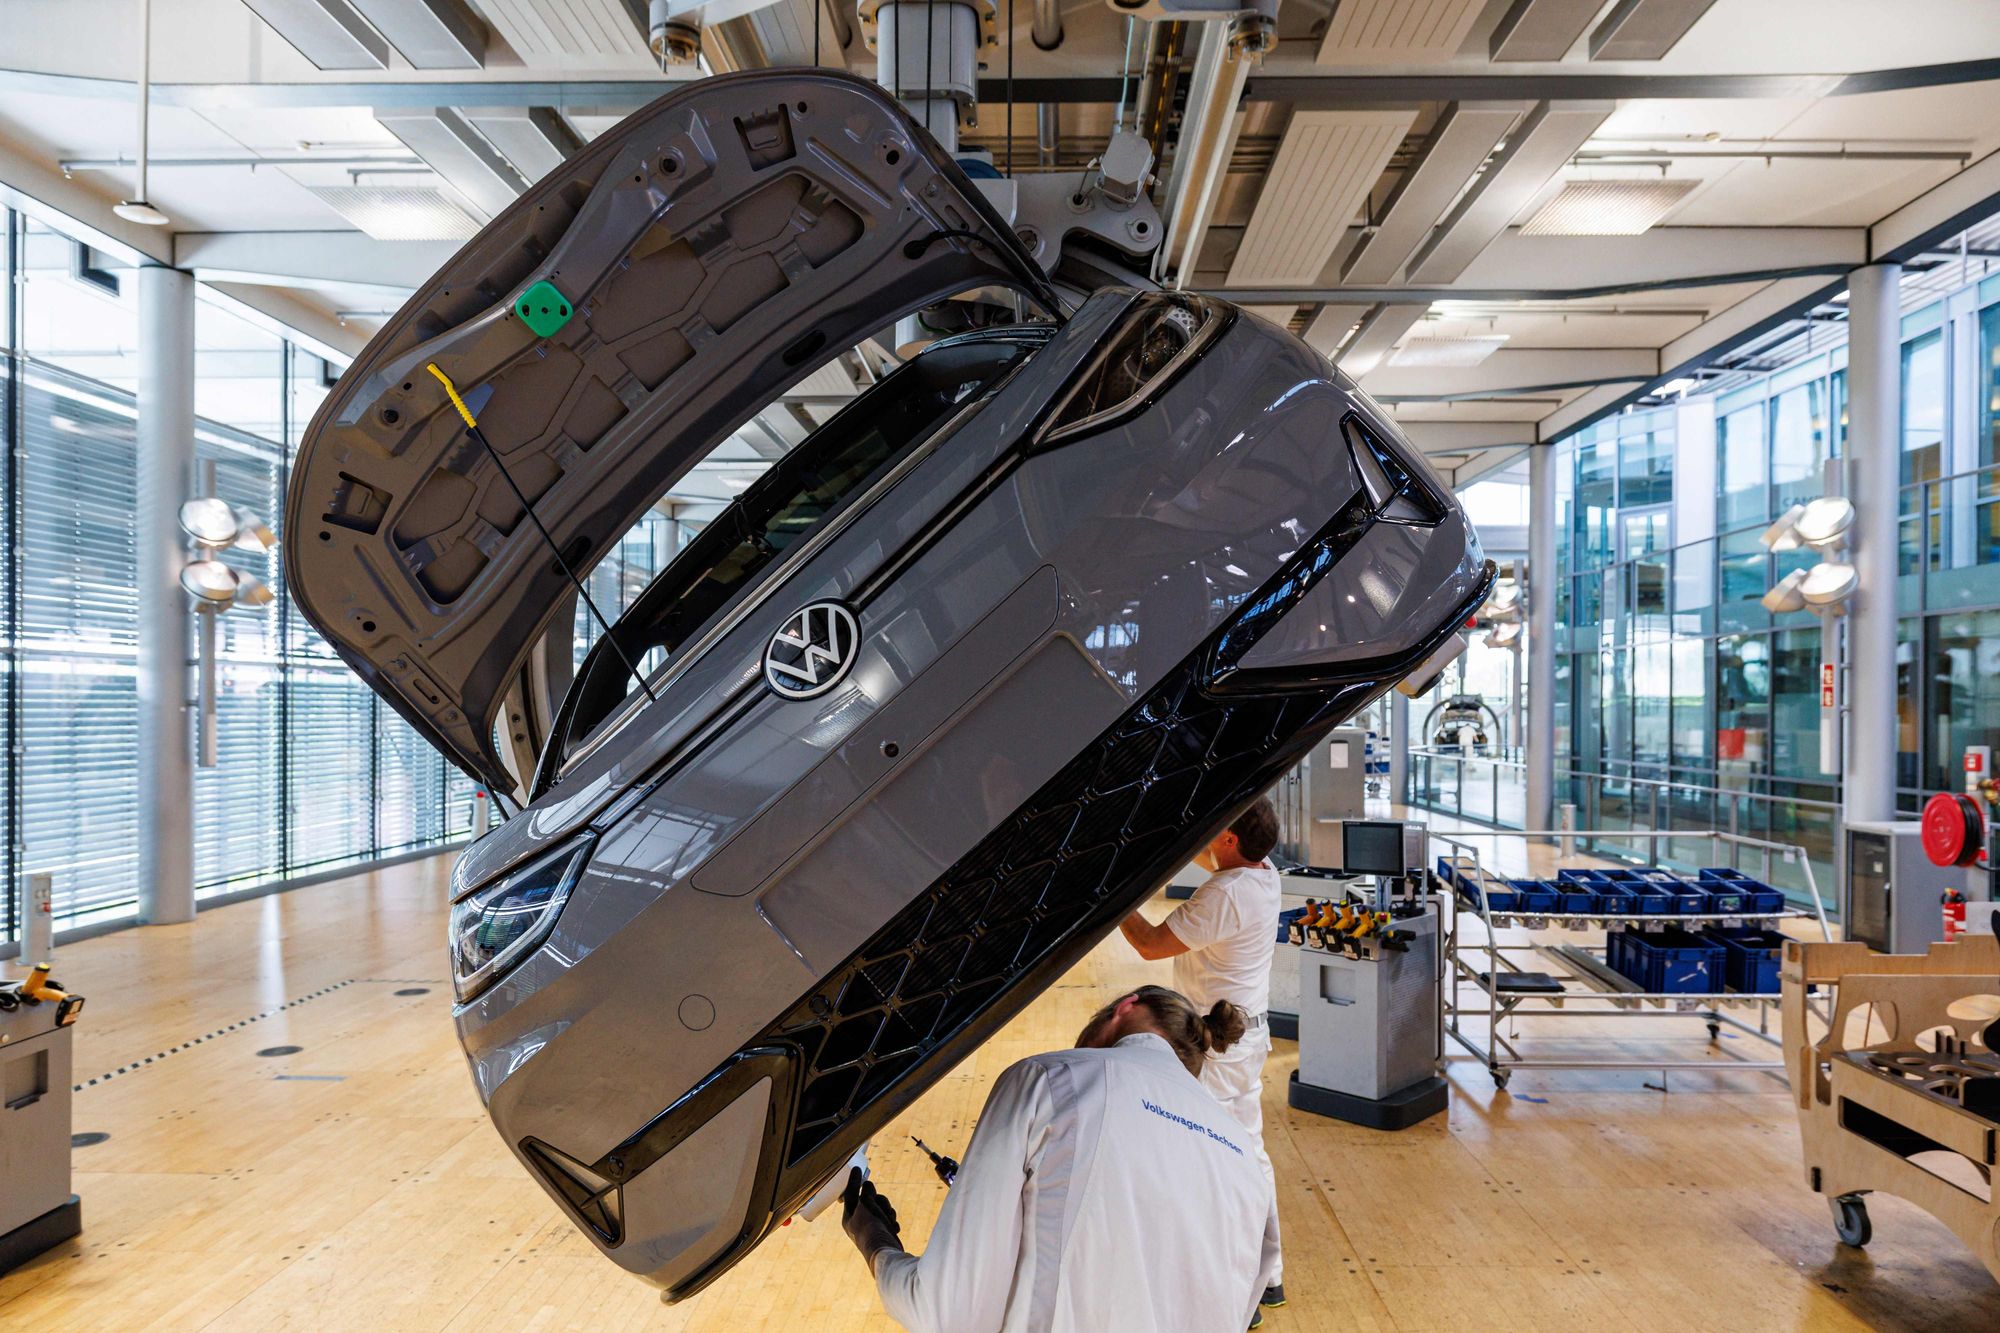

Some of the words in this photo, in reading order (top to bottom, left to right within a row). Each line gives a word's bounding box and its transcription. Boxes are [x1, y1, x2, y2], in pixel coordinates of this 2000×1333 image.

[766, 603, 845, 688] VW
[1141, 1098, 1206, 1134] Volkswagen
[1206, 1127, 1244, 1156] Sachsen
